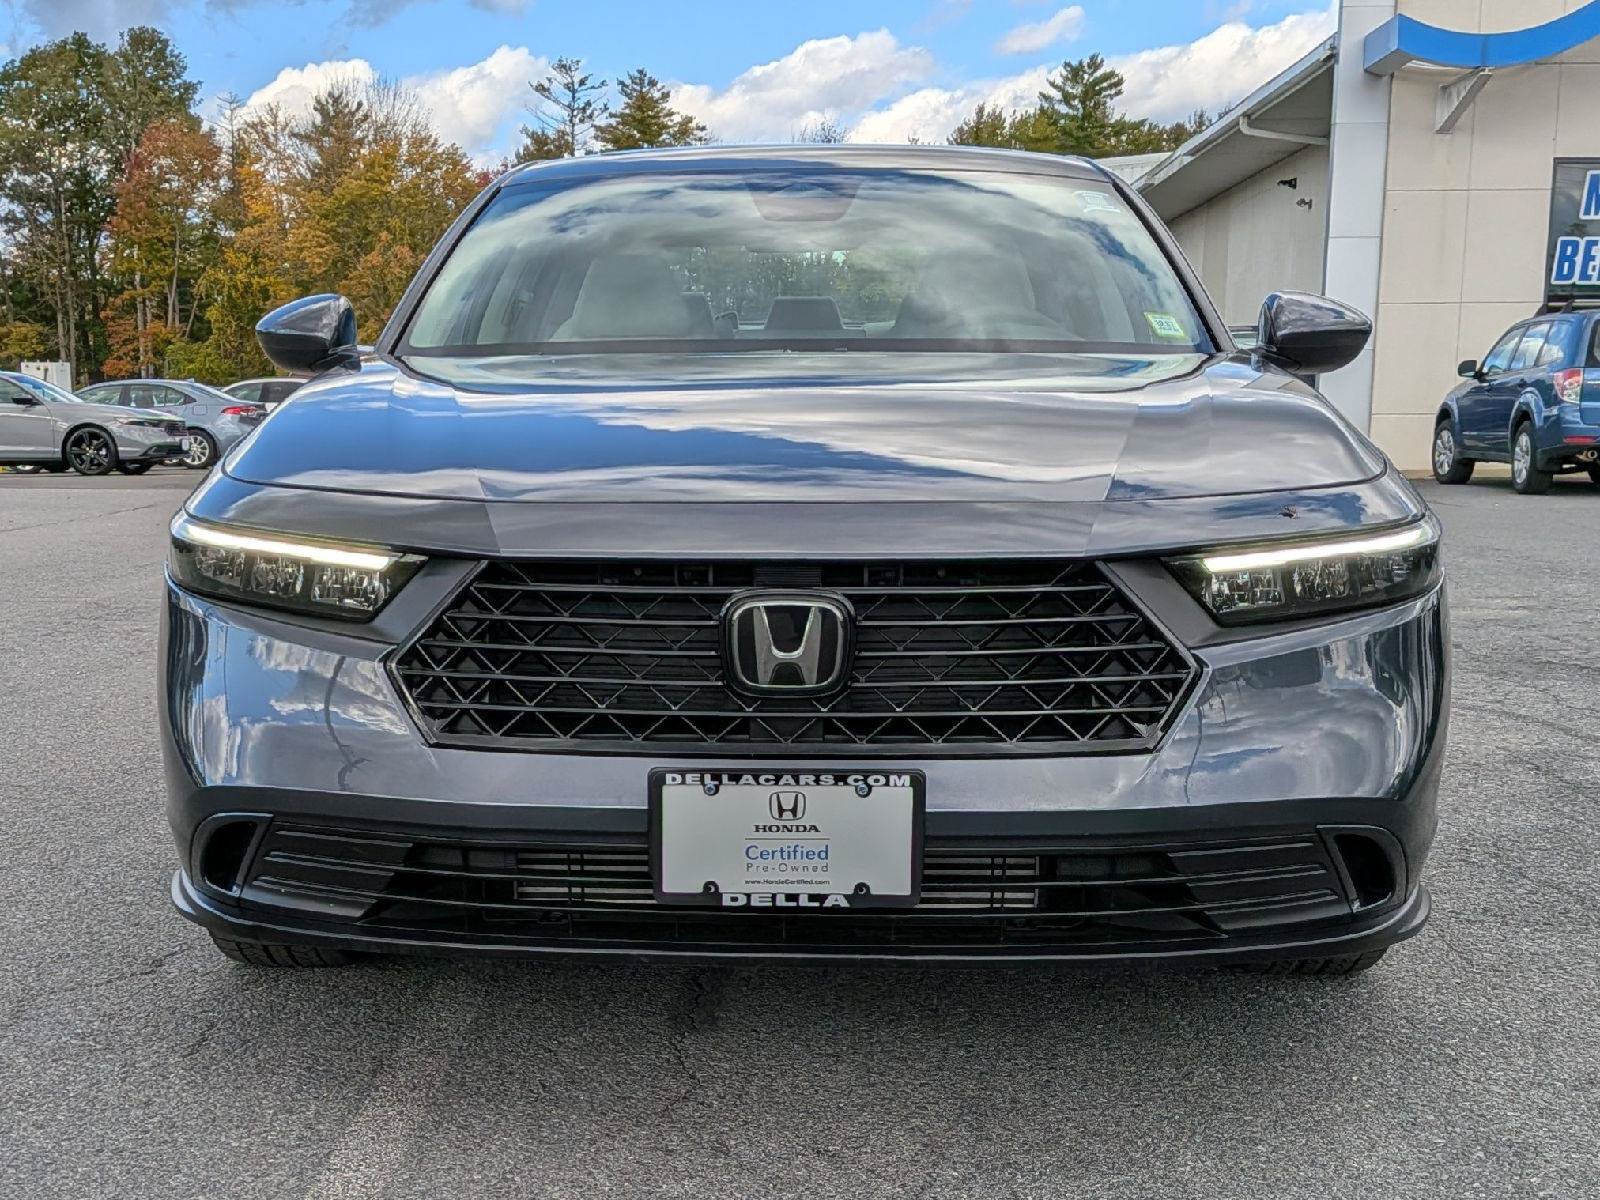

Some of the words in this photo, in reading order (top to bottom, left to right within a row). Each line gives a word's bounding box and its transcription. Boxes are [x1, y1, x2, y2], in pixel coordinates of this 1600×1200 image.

[1552, 237, 1600, 285] BE
[665, 773, 911, 787] DELLACARS.COM
[753, 824, 821, 833] HONDA
[745, 844, 829, 861] Certified
[746, 862, 829, 873] Pre-Owned
[722, 893, 851, 908] DELLA
